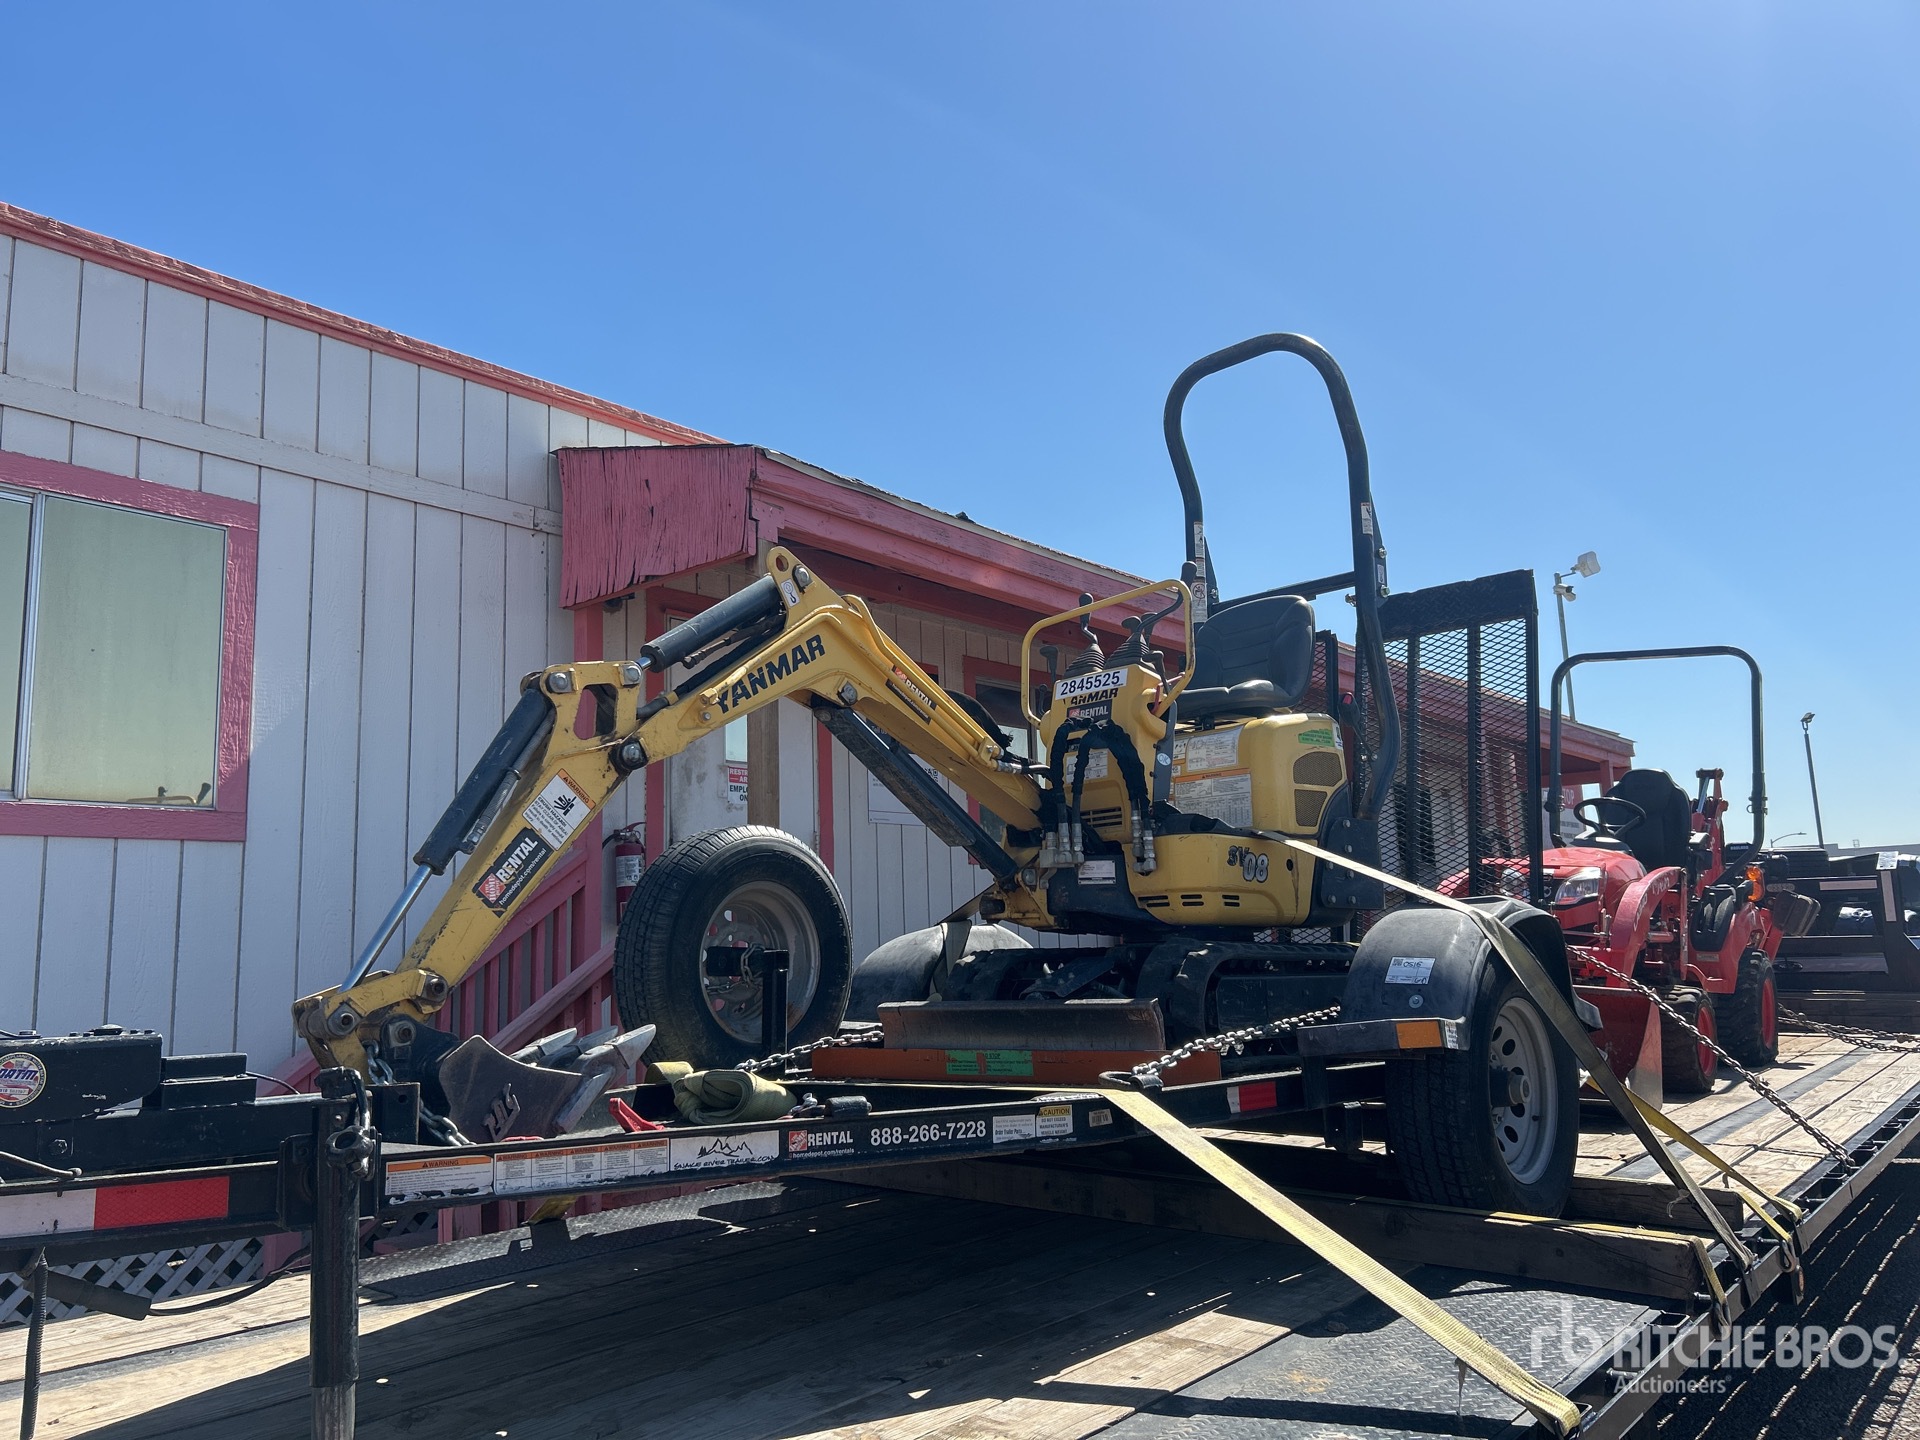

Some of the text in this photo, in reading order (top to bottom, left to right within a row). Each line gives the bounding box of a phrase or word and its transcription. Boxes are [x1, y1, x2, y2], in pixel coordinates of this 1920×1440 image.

[717, 634, 826, 714] YANMAR
[1060, 671, 1121, 696] 2845525
[1063, 687, 1119, 706] ANMAR
[1080, 705, 1109, 718] RENTAL
[730, 768, 748, 776] RESTR
[567, 780, 590, 804] WARNING
[730, 785, 749, 793] EMPL
[1562, 788, 1575, 806] OP
[496, 838, 539, 883] RENTAL
[499, 849, 548, 906] homedepot.com/rental
[1044, 1108, 1070, 1116] CAUTION
[807, 1131, 854, 1148] RENTAL
[870, 1121, 986, 1147] 888-266-7228
